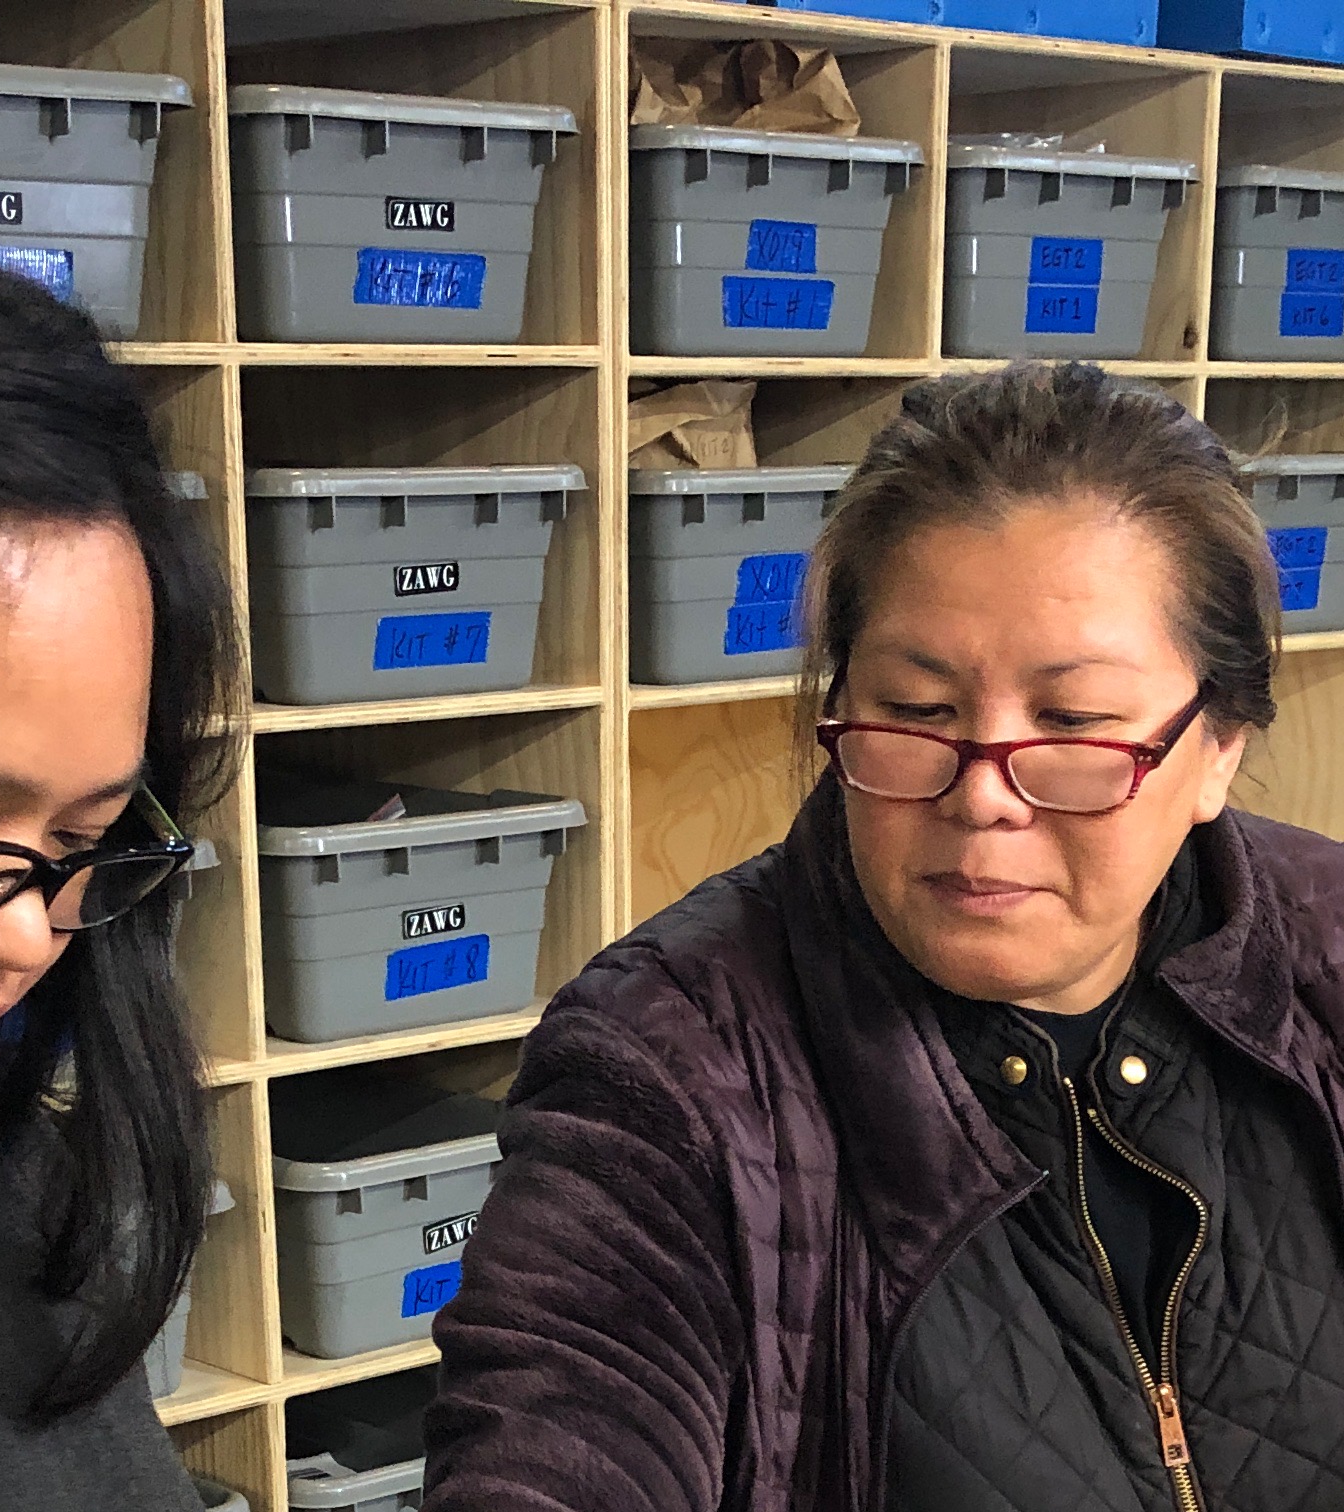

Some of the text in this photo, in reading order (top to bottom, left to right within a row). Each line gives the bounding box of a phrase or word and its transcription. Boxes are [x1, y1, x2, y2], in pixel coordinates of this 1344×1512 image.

[393, 203, 449, 227] ZAWG
[402, 565, 455, 591] ZAWG
[409, 907, 462, 936] ZAWG
[399, 959, 436, 998] KIT
[414, 1276, 452, 1315] KIT
